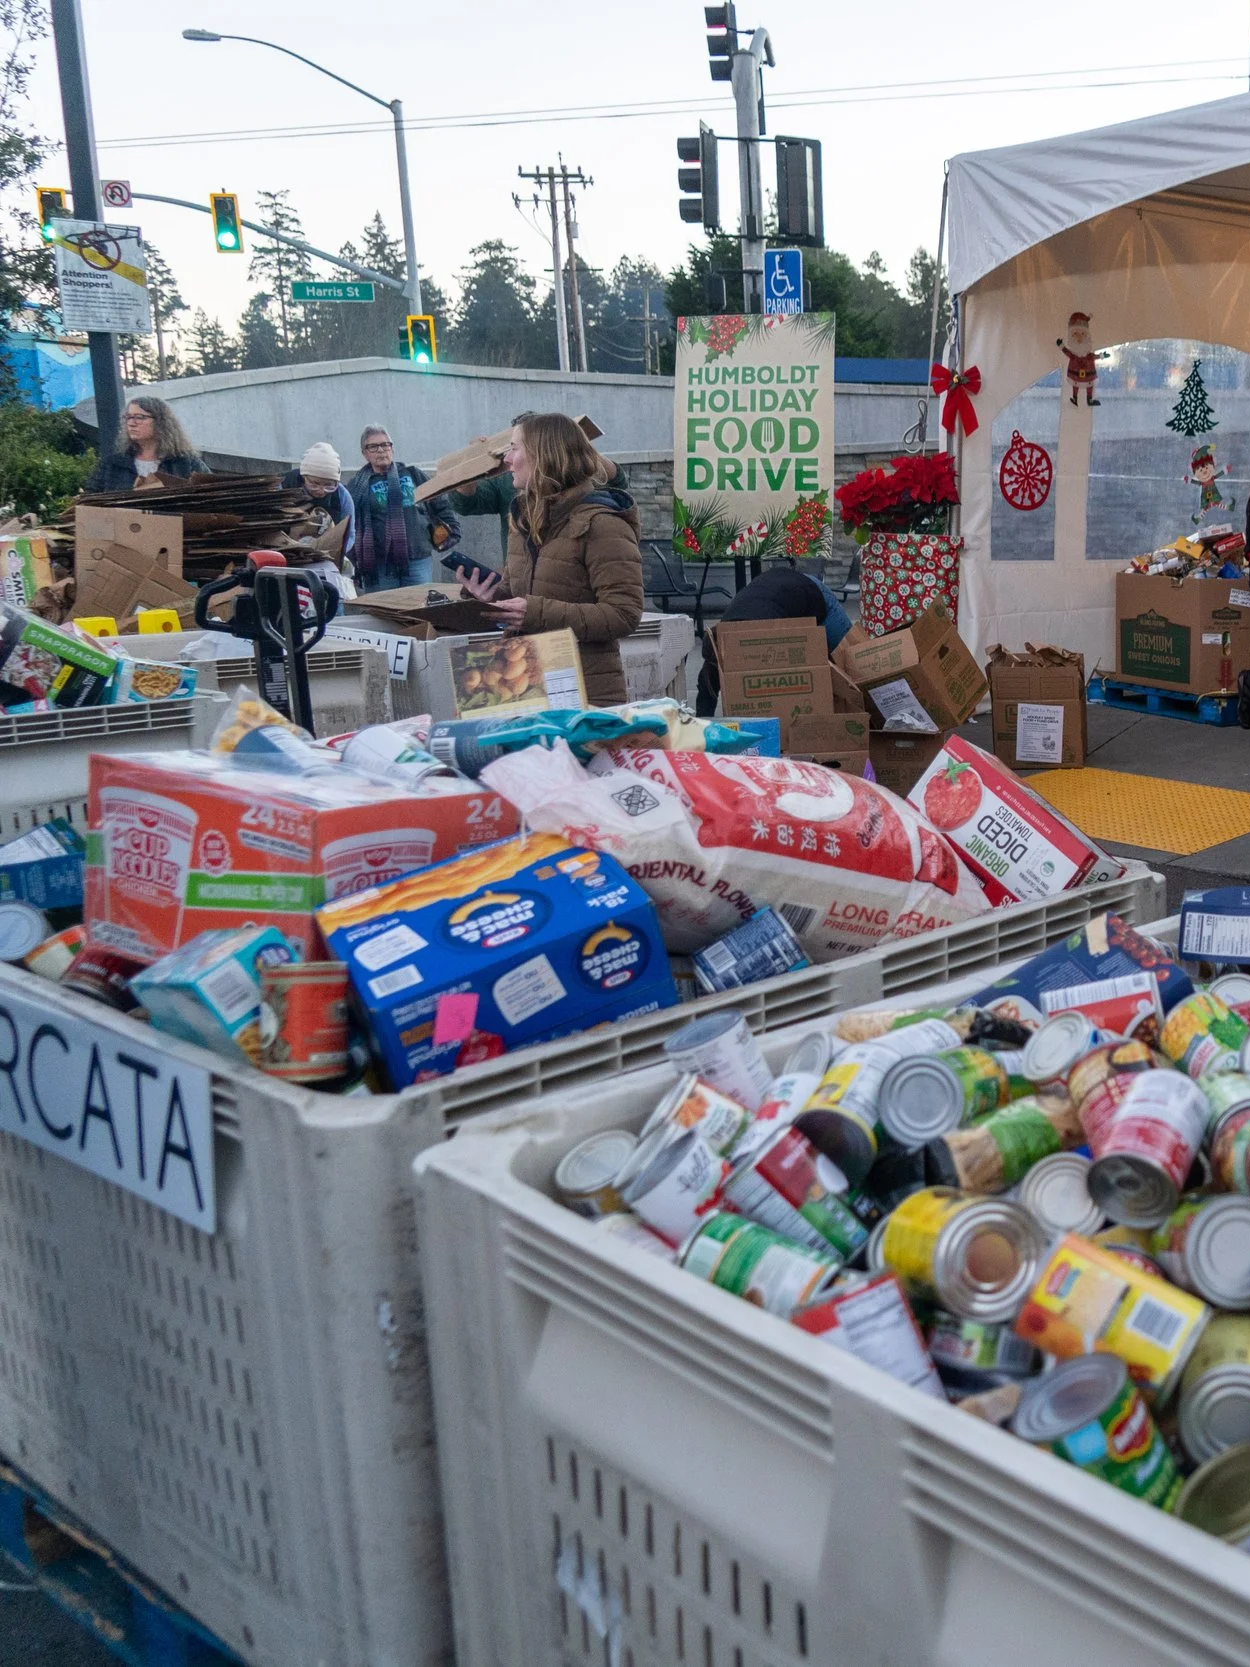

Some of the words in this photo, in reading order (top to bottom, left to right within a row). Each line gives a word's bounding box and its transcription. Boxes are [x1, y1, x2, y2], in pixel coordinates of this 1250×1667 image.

[62, 269, 108, 279] Attention
[63, 278, 113, 289] Shoppers!
[306, 286, 343, 297] Harris
[346, 287, 360, 297] St
[766, 298, 801, 314] PARKING
[688, 365, 820, 386] HUMBOLDT
[687, 388, 819, 413] HOLIDAY
[687, 417, 820, 454] FOOD
[686, 457, 819, 492] DRIVE
[1133, 633, 1173, 654] PREMIUM
[1128, 651, 1150, 661] SWEET
[1152, 654, 1181, 666] ONIONS
[730, 703, 755, 712] SMALL
[466, 798, 503, 824] 24
[995, 805, 1034, 843] TOMATOES
[124, 828, 170, 857] CUP
[977, 814, 1029, 864] DICED
[965, 834, 1010, 878] ORGANIC
[111, 850, 181, 889] NOODLES
[585, 884, 629, 909] pack
[603, 893, 627, 910] 18
[627, 860, 707, 887] RIENTAL
[711, 879, 757, 921] FLOWE
[481, 908, 535, 936] mac
[829, 901, 889, 927] LONG
[460, 928, 482, 945] &
[823, 919, 882, 937] PREMIUM
[588, 966, 604, 981] &
[601, 952, 639, 974] mac
[0, 1003, 204, 1212] RCATA
